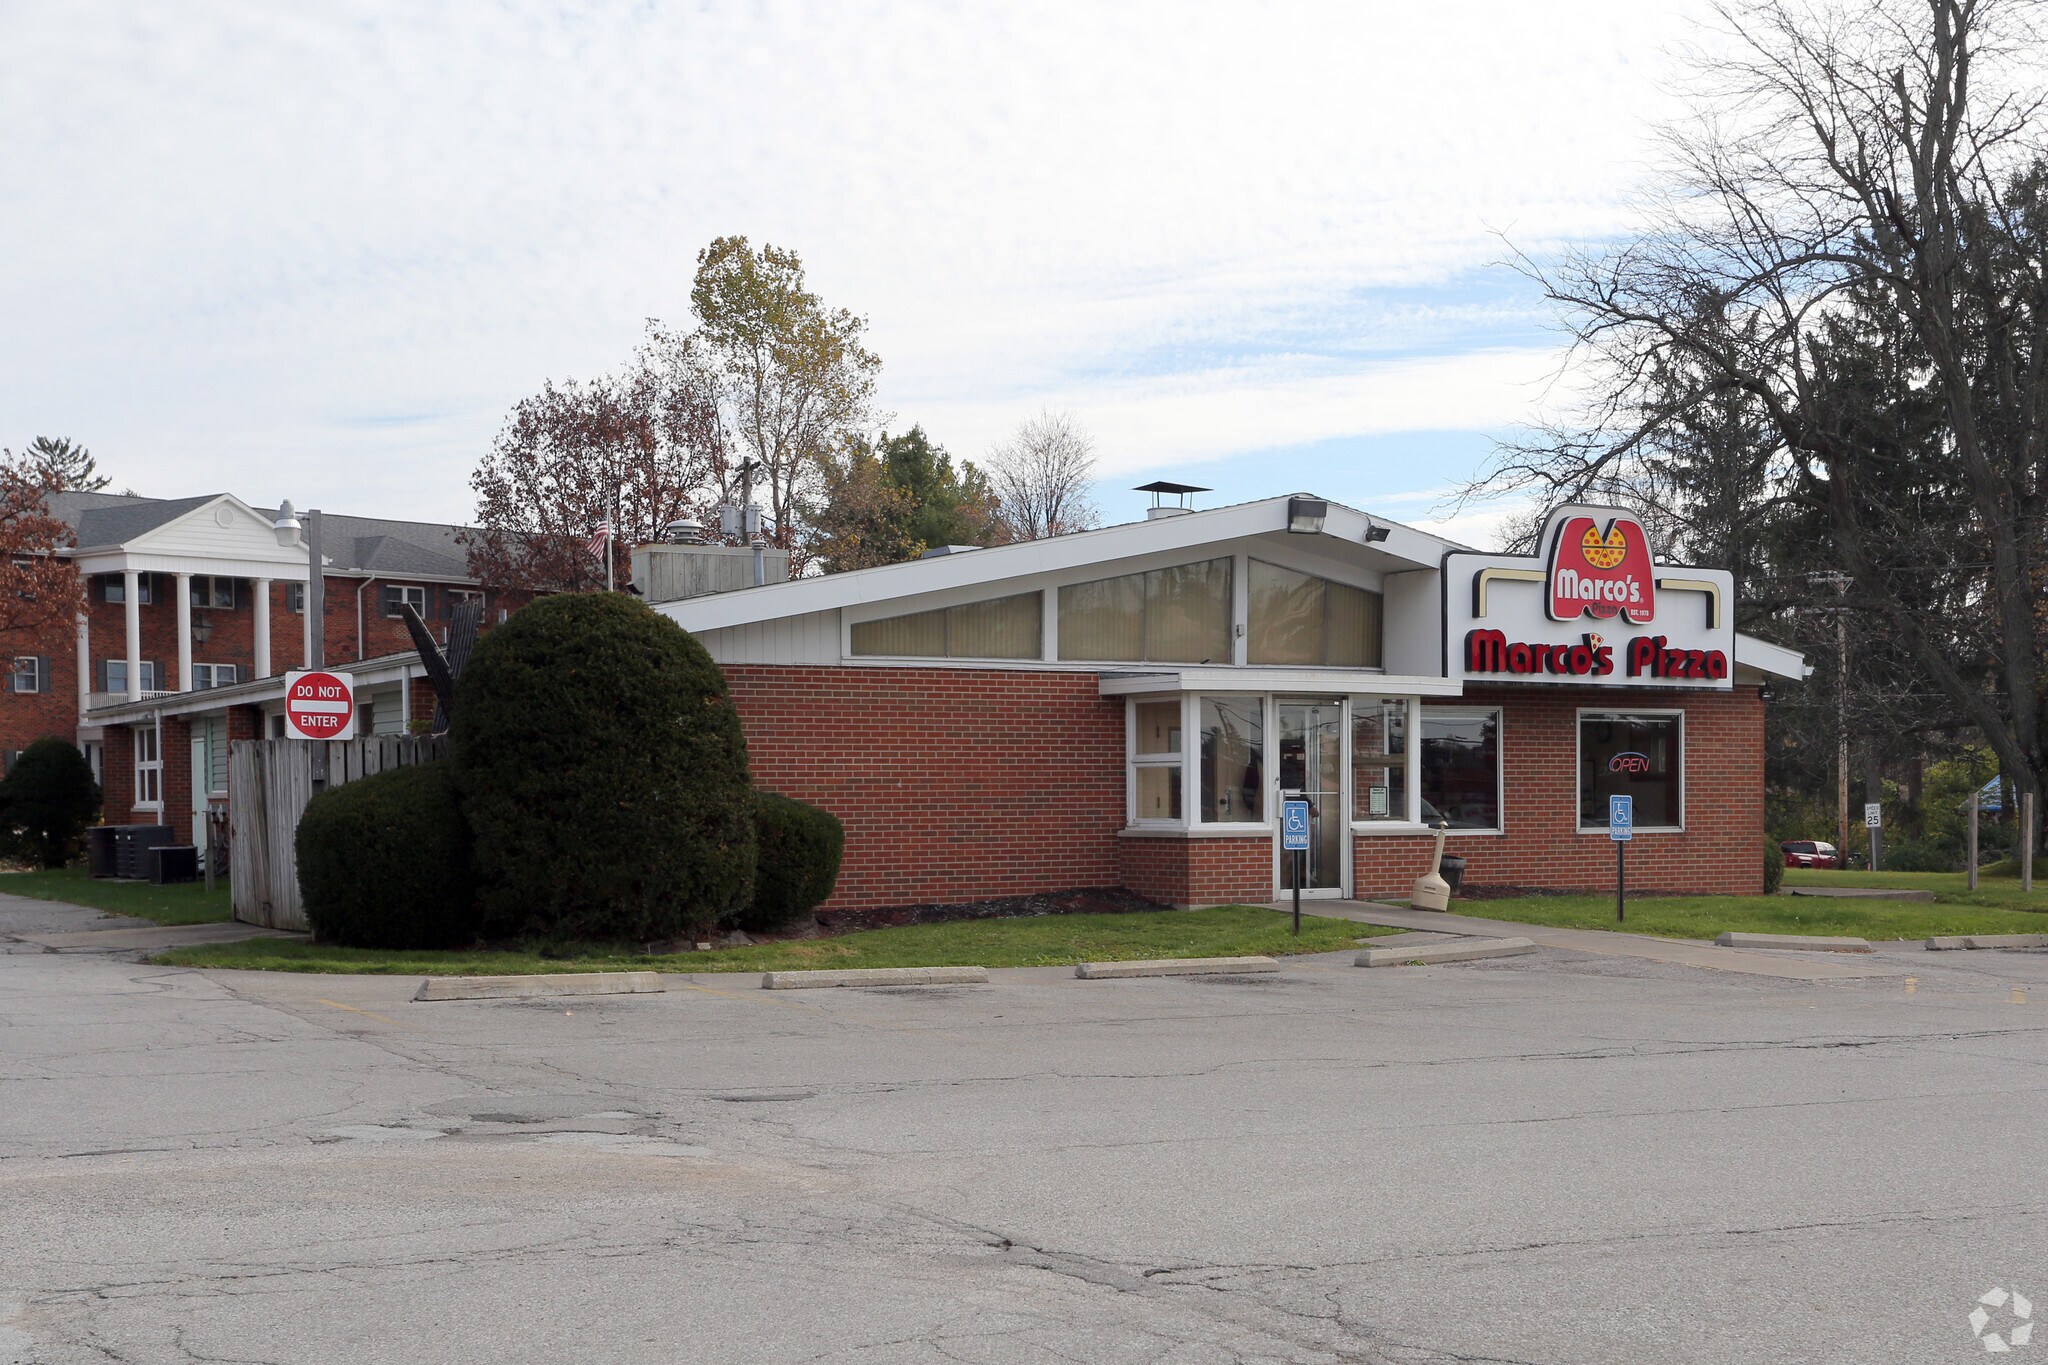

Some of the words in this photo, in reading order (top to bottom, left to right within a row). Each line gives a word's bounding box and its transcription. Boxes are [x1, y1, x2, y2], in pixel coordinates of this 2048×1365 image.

[1557, 568, 1640, 603] Marco's
[1591, 602, 1618, 614] Pizza
[1465, 629, 1614, 676] Marco's
[1627, 635, 1728, 680] Pizza
[297, 685, 313, 697] DO
[318, 686, 341, 698] NOT
[301, 715, 338, 727] ENTER
[1611, 758, 1650, 772] OPEN
[1867, 816, 1879, 825] 25
[1285, 834, 1308, 845] PARKING
